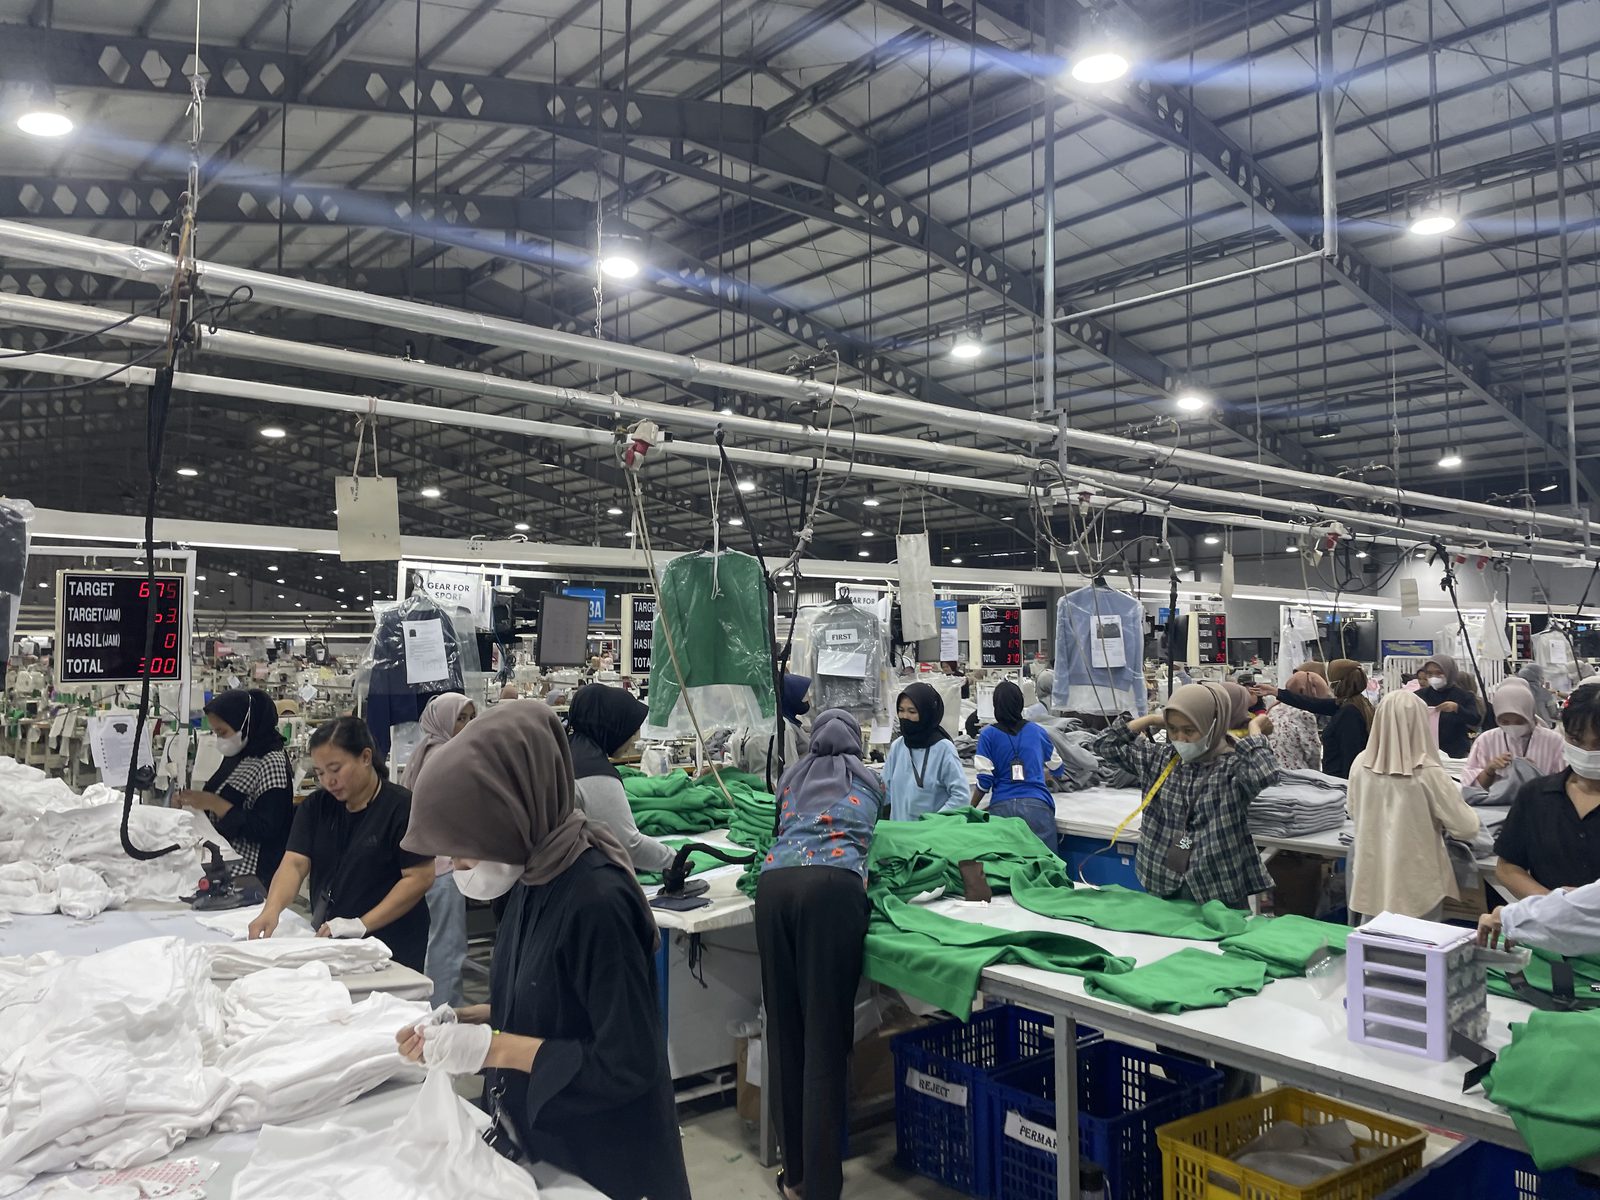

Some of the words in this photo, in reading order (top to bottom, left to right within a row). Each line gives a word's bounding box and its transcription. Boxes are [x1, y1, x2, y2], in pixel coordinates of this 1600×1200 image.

[69, 582, 115, 596] TARGET
[427, 582, 451, 591] GEAR
[453, 584, 470, 592] FOR
[435, 592, 463, 600] SPORT
[68, 607, 121, 622] TARGET(JAM)
[67, 633, 121, 647] HASIL(JAM)
[164, 633, 177, 649] 0
[831, 633, 852, 641] FIRST
[66, 659, 104, 674] TOTAL
[919, 1079, 950, 1098] REJECT
